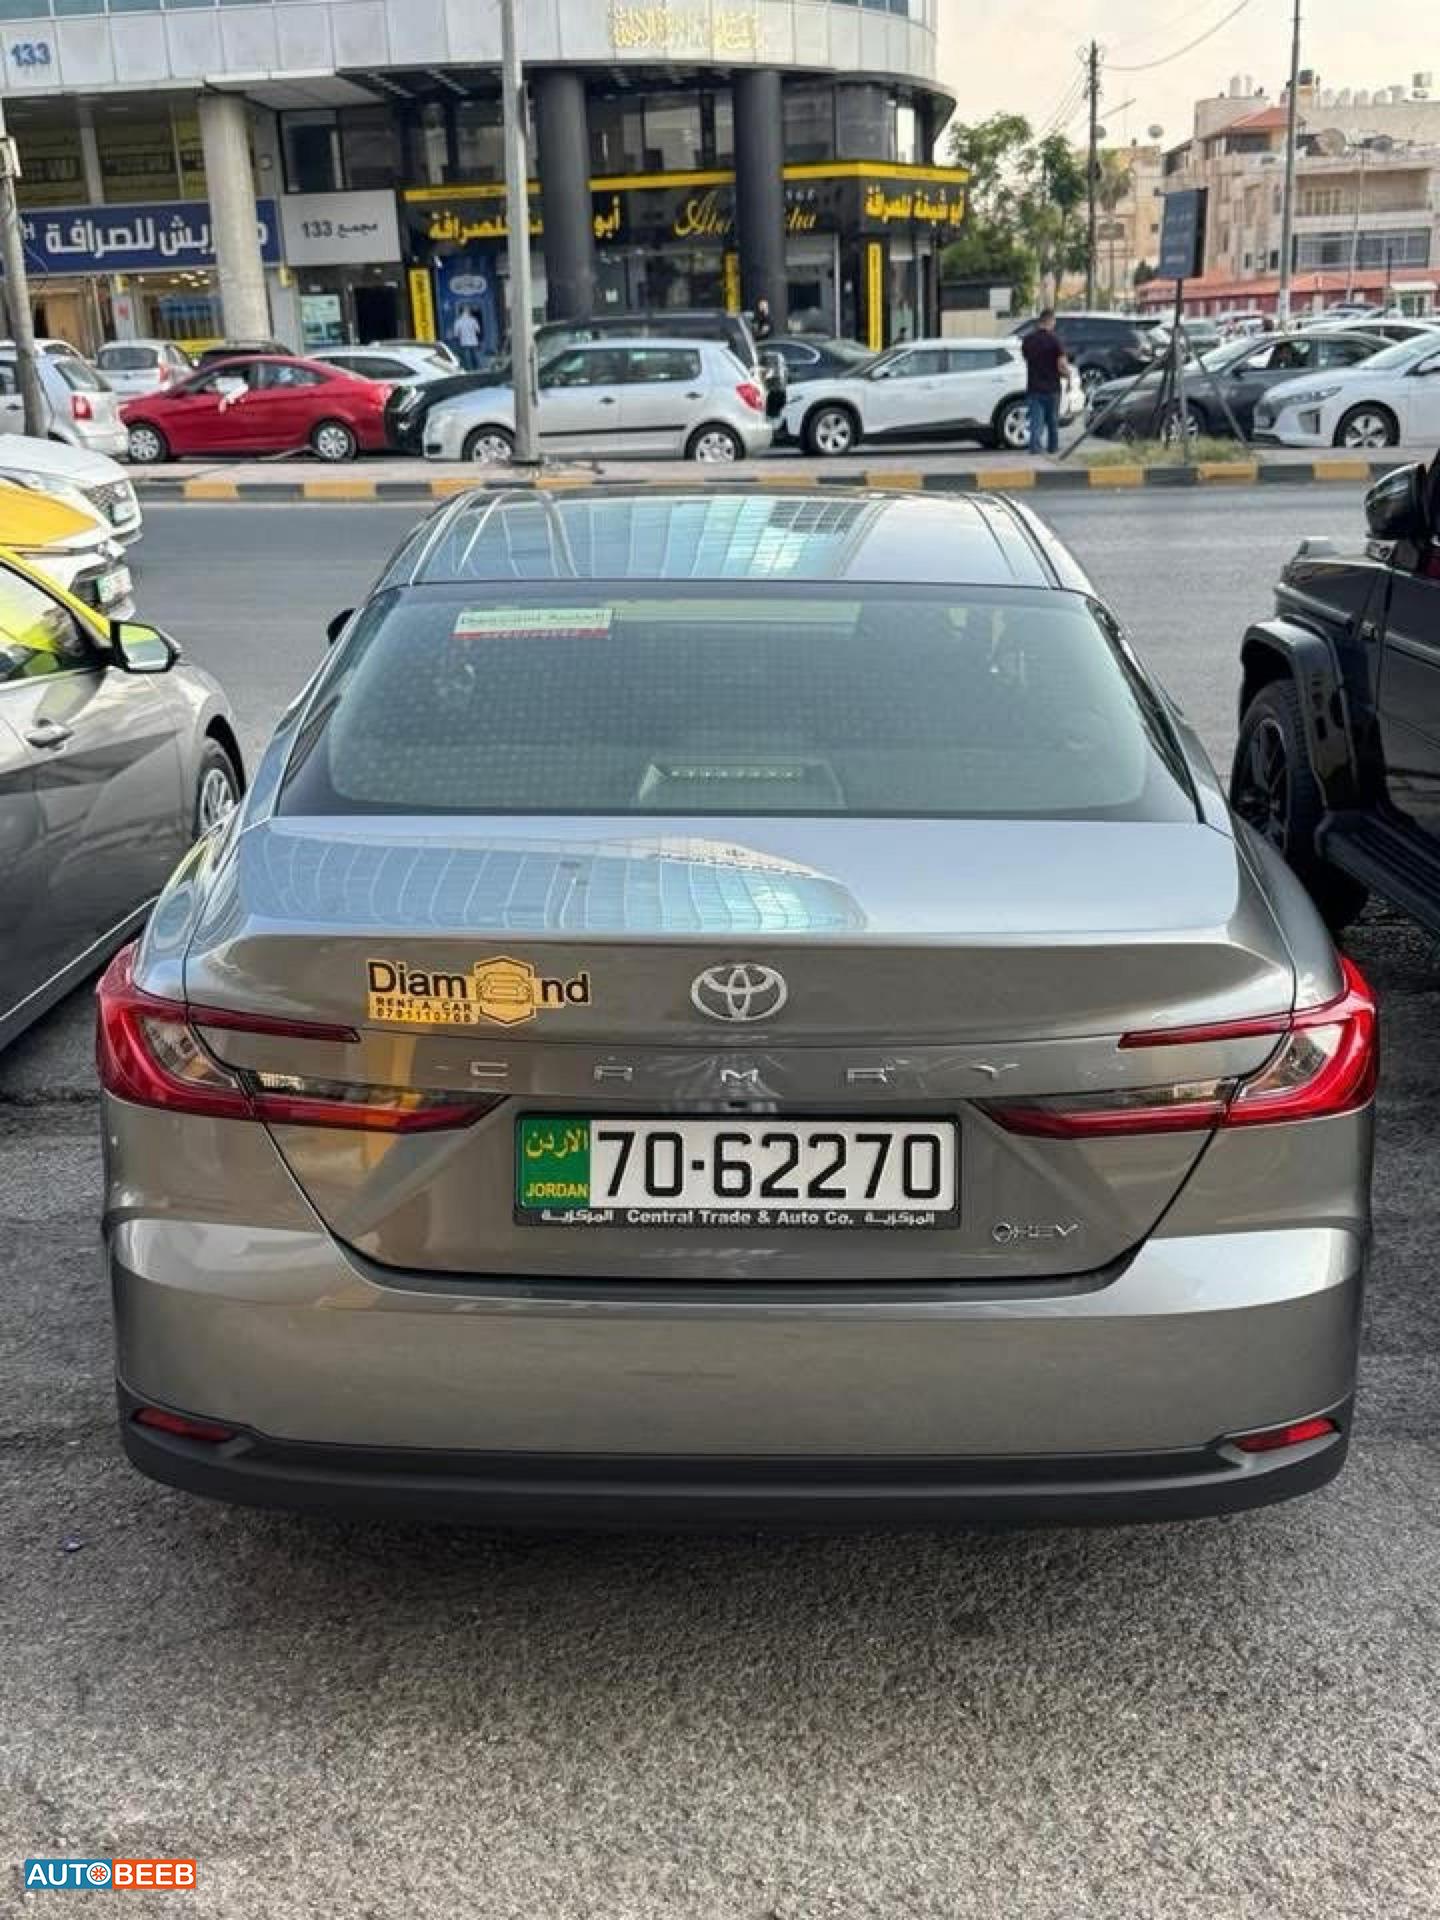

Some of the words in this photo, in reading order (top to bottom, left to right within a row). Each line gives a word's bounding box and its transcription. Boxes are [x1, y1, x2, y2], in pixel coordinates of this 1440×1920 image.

[11, 42, 51, 67] 133
[45, 217, 155, 258] للصرافة
[302, 220, 332, 239] 133
[375, 996, 415, 1009] RENT
[422, 1001, 431, 1009] A
[442, 1002, 472, 1012] CAR
[471, 1060, 1020, 1083] CAMRY
[597, 1131, 942, 1199] 70-62270
[525, 1183, 589, 1198] JORDAN
[627, 1209, 693, 1223] Central
[699, 1209, 751, 1223] Trade
[757, 1210, 770, 1224] &
[777, 1211, 819, 1224] Auto
[824, 1211, 854, 1225] Co.
